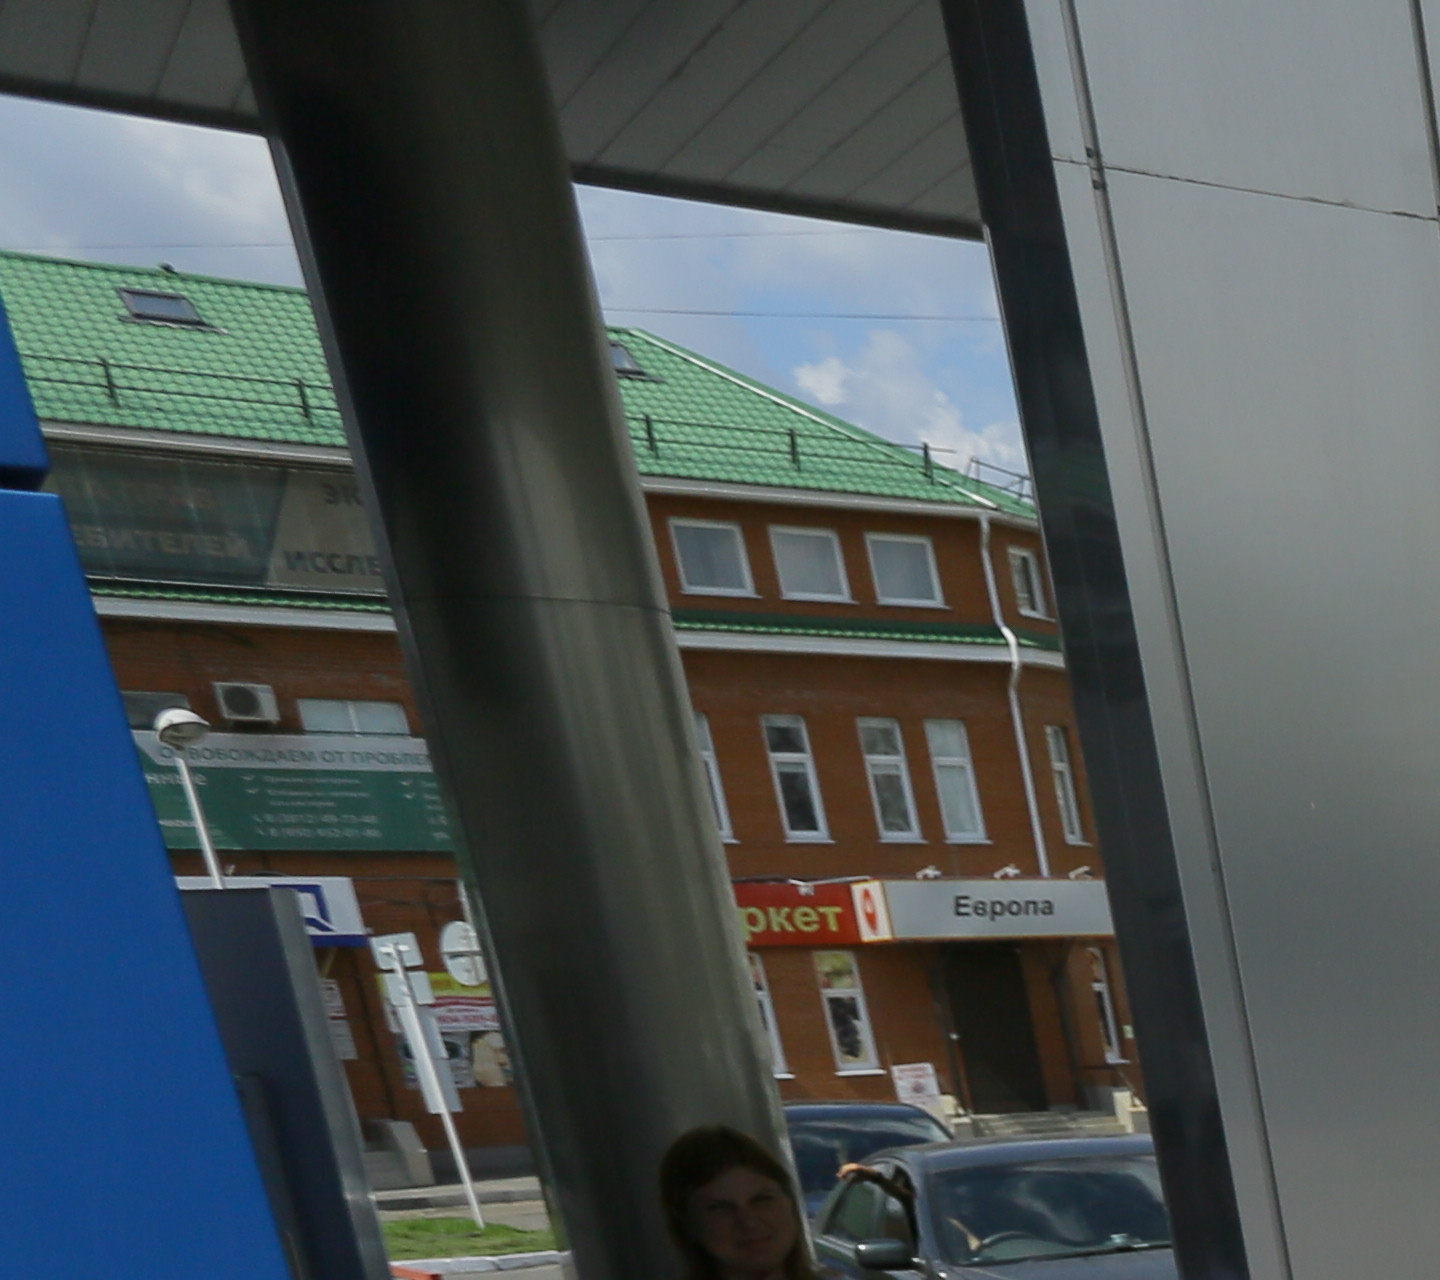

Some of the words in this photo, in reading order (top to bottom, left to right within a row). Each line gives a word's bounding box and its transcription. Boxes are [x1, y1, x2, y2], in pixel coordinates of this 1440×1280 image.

[160, 746, 315, 765] ОВОБОЖДАЕМ
[322, 749, 345, 763] ОТ
[954, 895, 1055, 922] Европа
